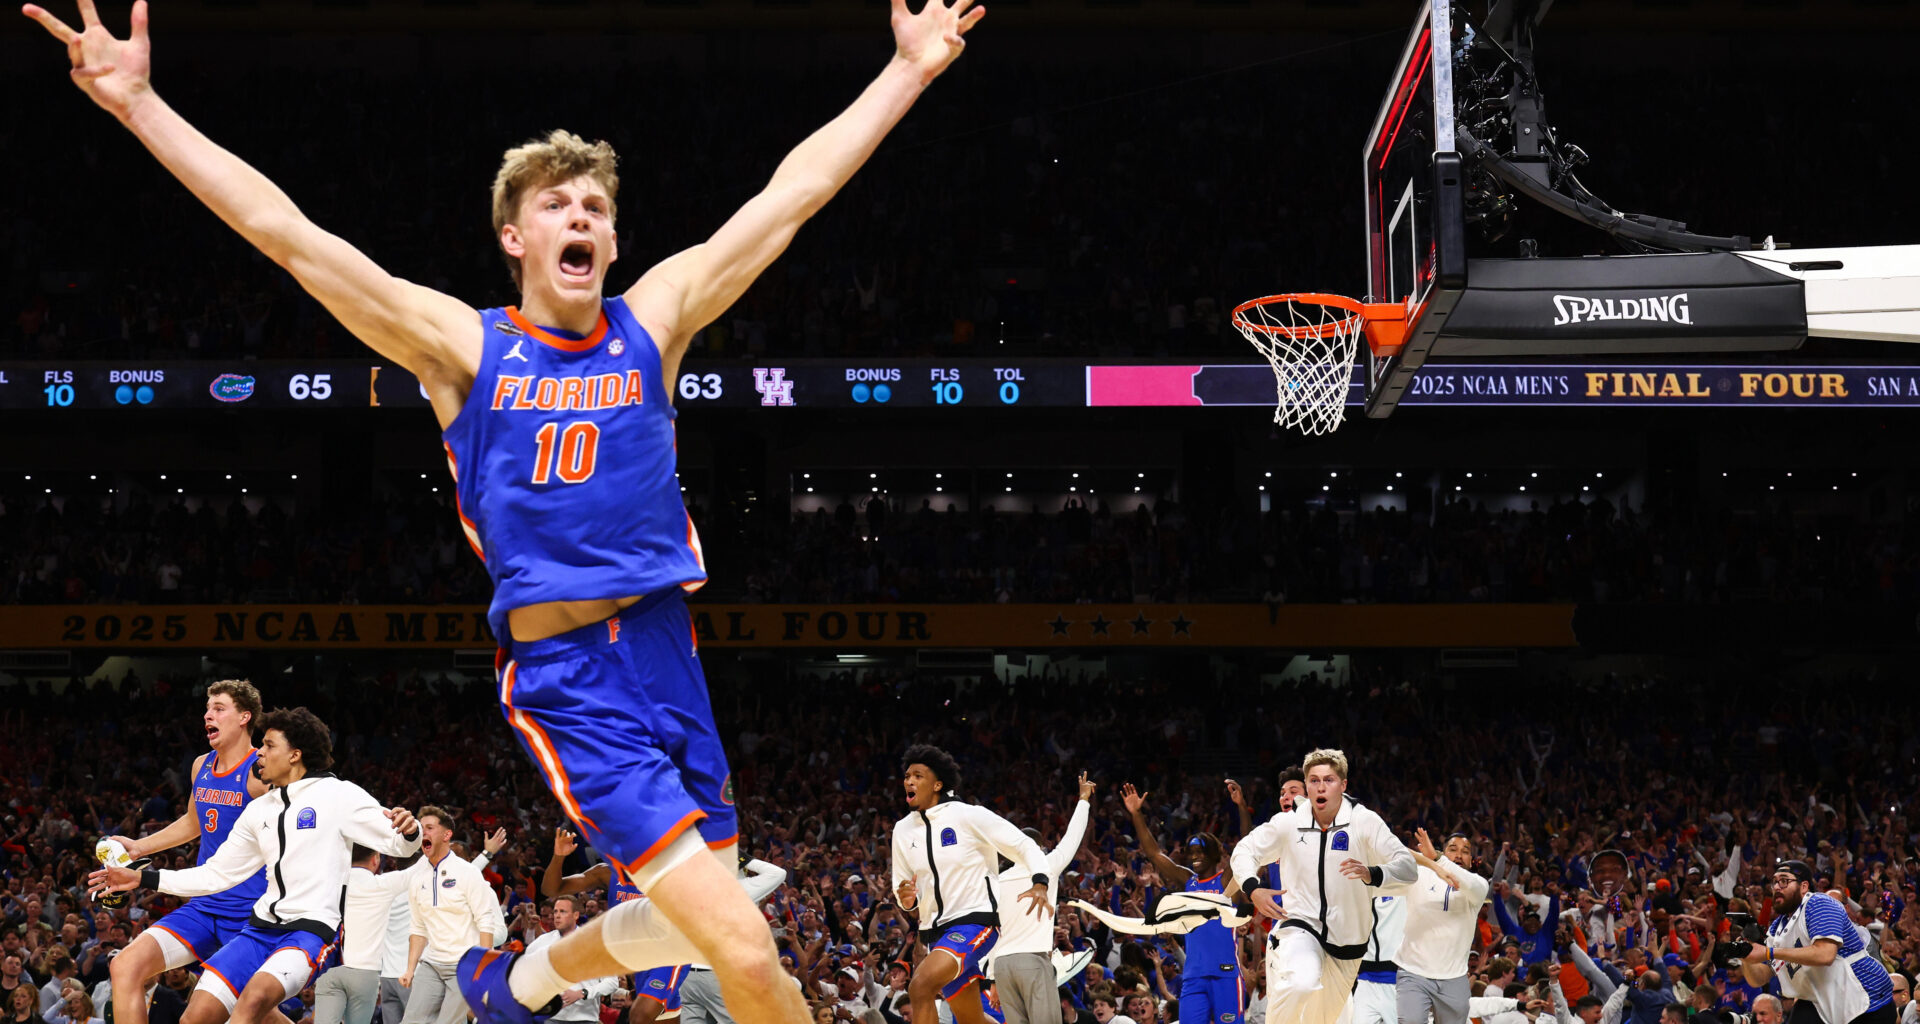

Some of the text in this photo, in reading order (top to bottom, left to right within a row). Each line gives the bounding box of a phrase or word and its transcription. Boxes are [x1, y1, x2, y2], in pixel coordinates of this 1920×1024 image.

[1552, 293, 1691, 325] SPALDING
[44, 371, 74, 384] FLS
[109, 370, 165, 383] BONUS
[288, 373, 332, 400] 65
[678, 373, 723, 400] 63
[845, 368, 902, 382] BONUS
[930, 368, 961, 382] FLS
[993, 368, 1026, 382] TOL
[1411, 375, 1455, 395] 2025
[1462, 375, 1509, 395] NCAA
[1515, 375, 1570, 395] MEN'S
[1584, 372, 1711, 397] FINAL
[1739, 373, 1849, 398] FOUR
[1867, 376, 1901, 396] SAN
[44, 384, 75, 407] 10
[489, 369, 643, 411] FLORIDA
[931, 382, 964, 405] 10
[999, 381, 1020, 405] 0
[531, 420, 600, 485] 10
[62, 614, 187, 642] 2025
[212, 611, 361, 643] NCAA
[384, 612, 498, 642] MEN
[782, 612, 932, 641] FOUR
[607, 617, 620, 644] F
[195, 786, 243, 807] FLORIDA
[205, 808, 219, 833] 3
